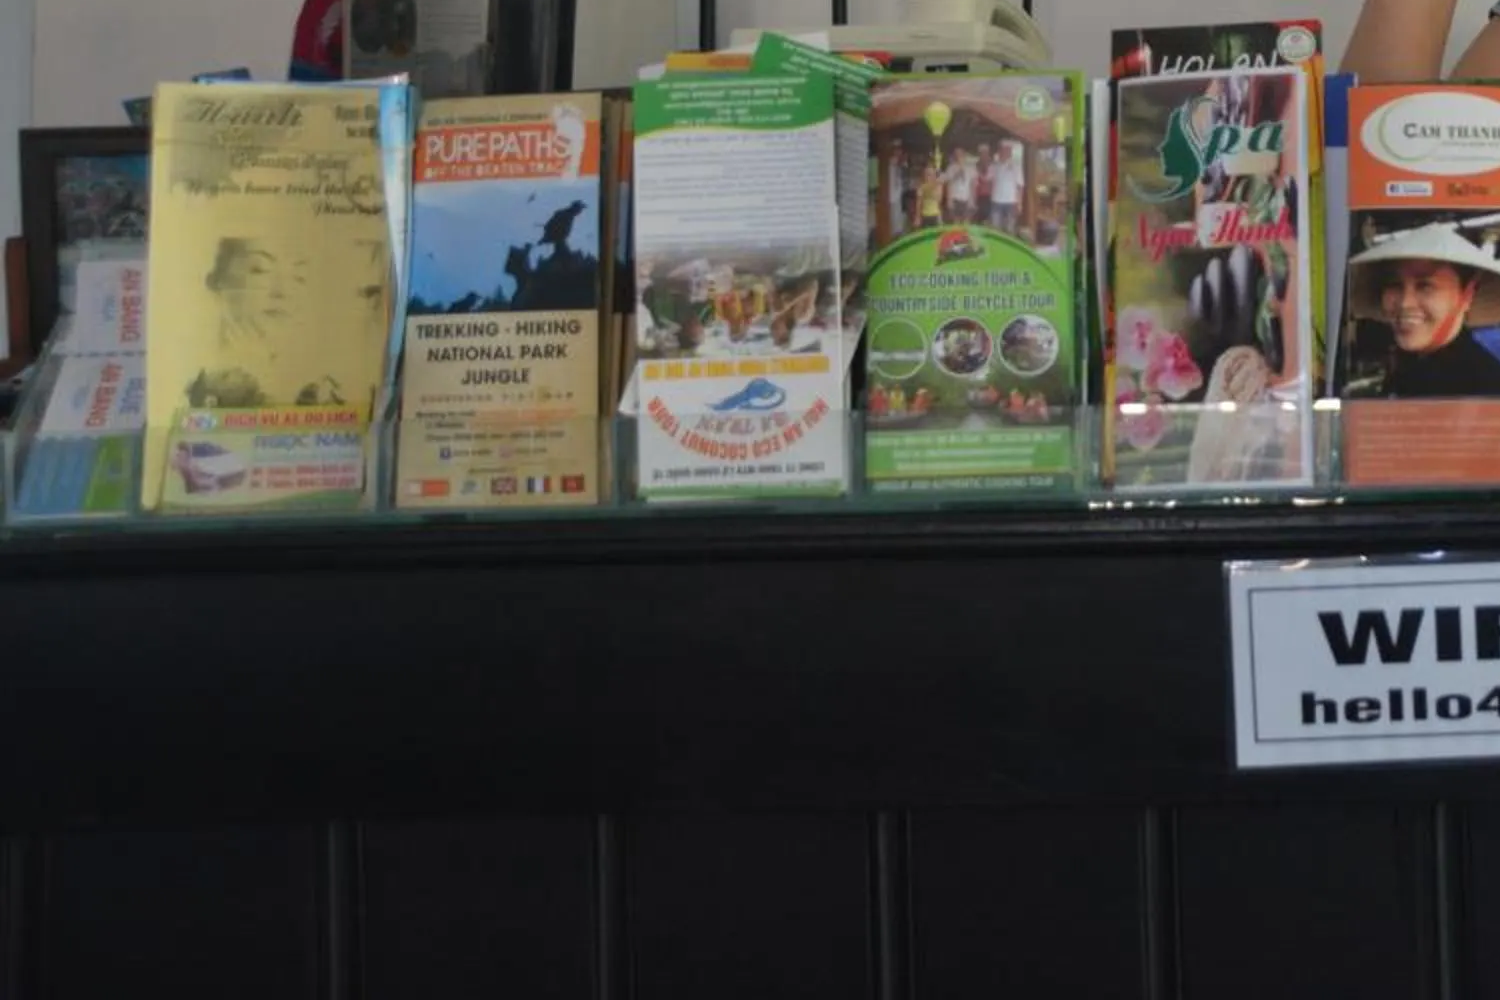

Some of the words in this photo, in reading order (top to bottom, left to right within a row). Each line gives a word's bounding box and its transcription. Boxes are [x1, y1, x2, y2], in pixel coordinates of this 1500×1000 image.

[1403, 122, 1442, 139] CAM
[416, 321, 499, 340] TREKKING
[515, 319, 582, 336] HIKING
[427, 345, 514, 363] NATIONAL
[519, 343, 568, 360] PARK
[460, 367, 531, 385] JUNGLE
